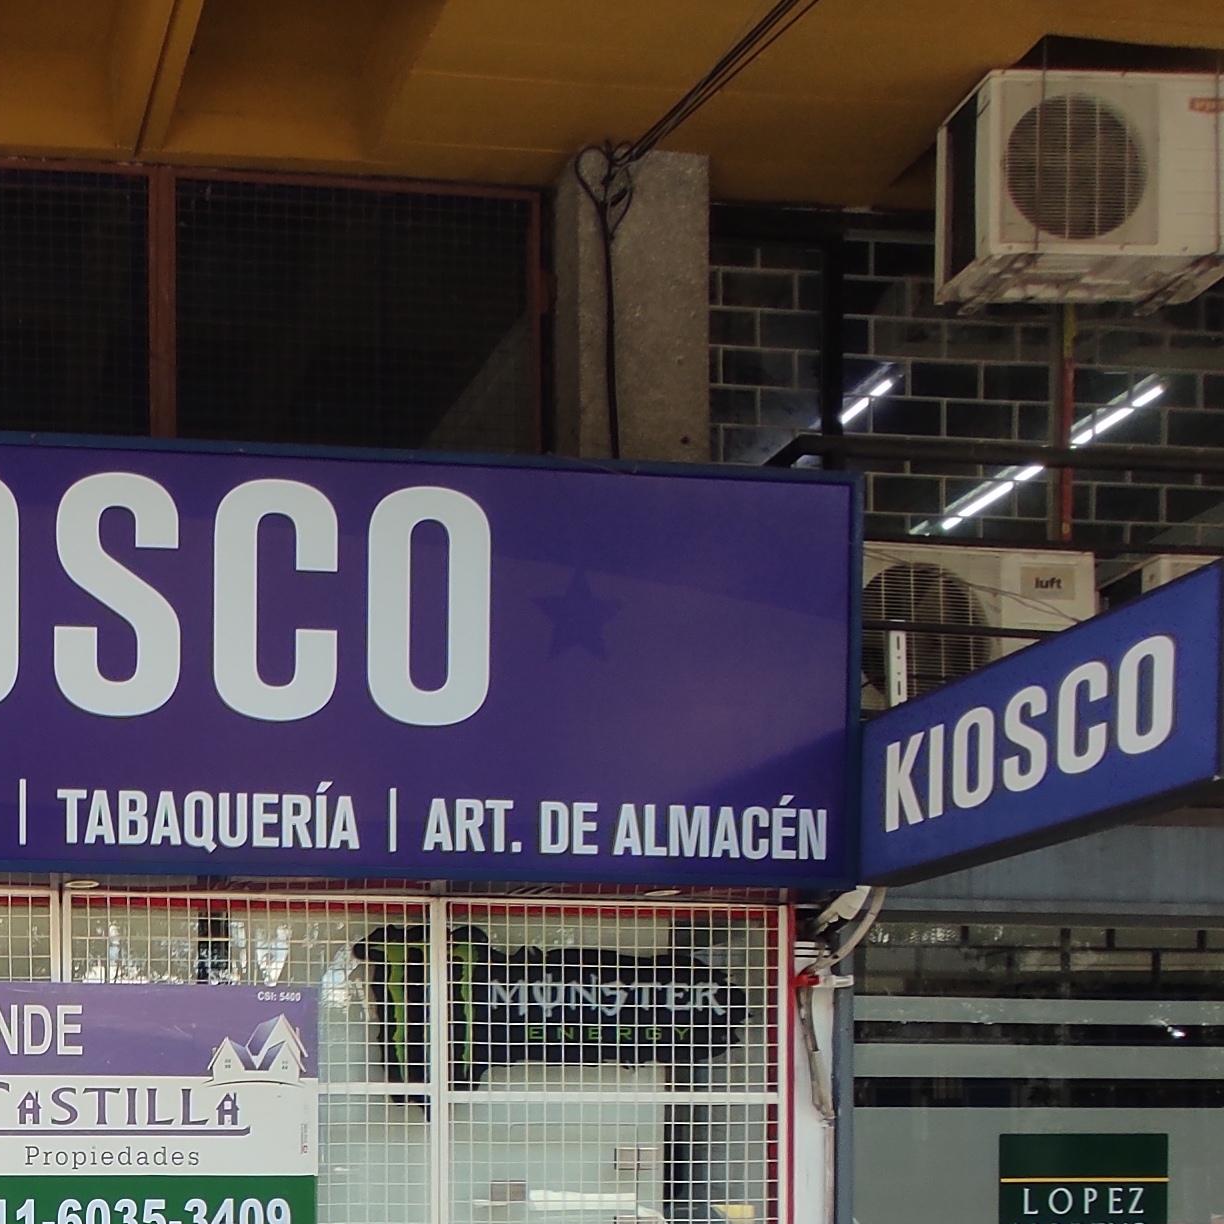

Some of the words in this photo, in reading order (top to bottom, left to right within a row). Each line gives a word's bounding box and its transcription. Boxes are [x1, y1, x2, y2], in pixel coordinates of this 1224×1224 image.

[1034, 576, 1063, 590] luft
[885, 634, 1175, 833] KIOSCO
[56, 780, 361, 854] TABAQUERÍA
[422, 797, 523, 855] ART.
[539, 800, 599, 856] DE
[612, 794, 828, 861] ALMACÉN
[491, 972, 726, 1018] MONSTER
[527, 1026, 690, 1041] ENERGY
[24, 1144, 201, 1170] Propiedades
[1022, 1187, 1145, 1216] LOPEZ
